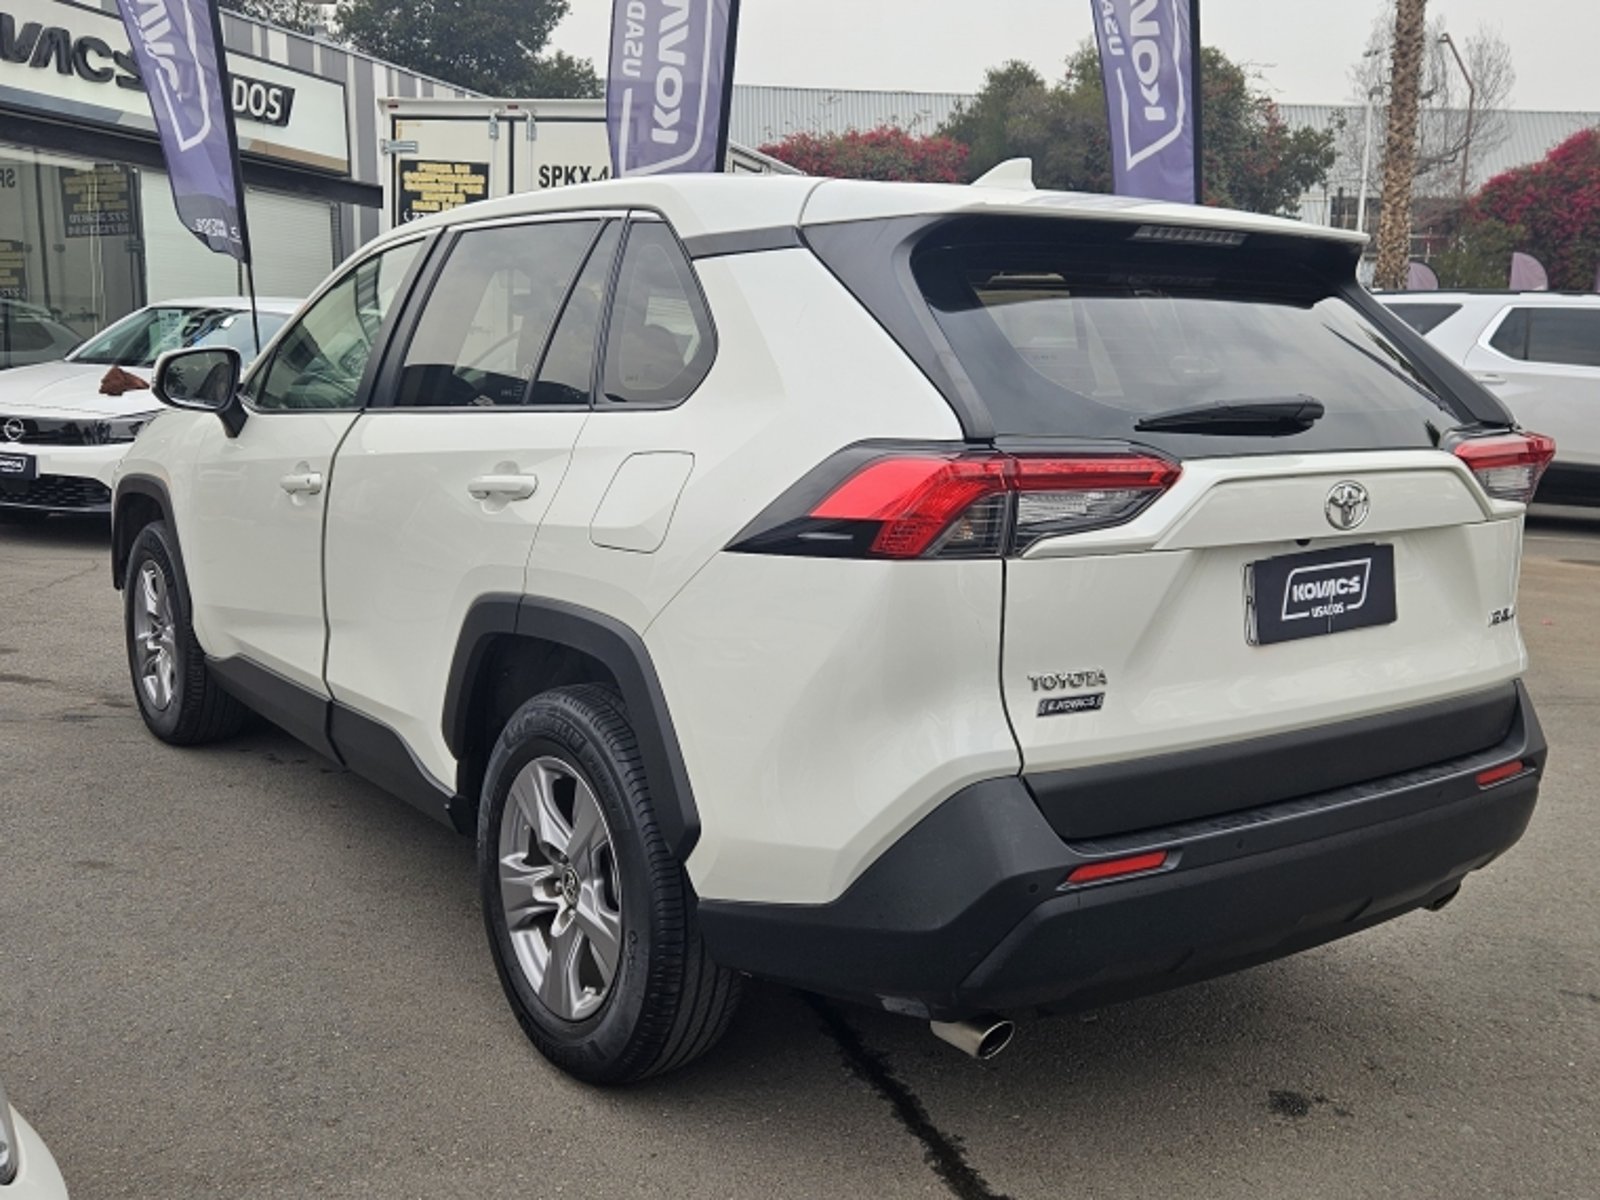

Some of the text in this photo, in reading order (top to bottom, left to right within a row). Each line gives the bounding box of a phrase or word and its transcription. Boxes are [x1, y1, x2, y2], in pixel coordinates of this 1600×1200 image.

[232, 78, 283, 121] DOS
[1292, 575, 1361, 603] KOVACS
[1311, 601, 1345, 618] USADOS
[1027, 669, 1108, 692] TOYOTA
